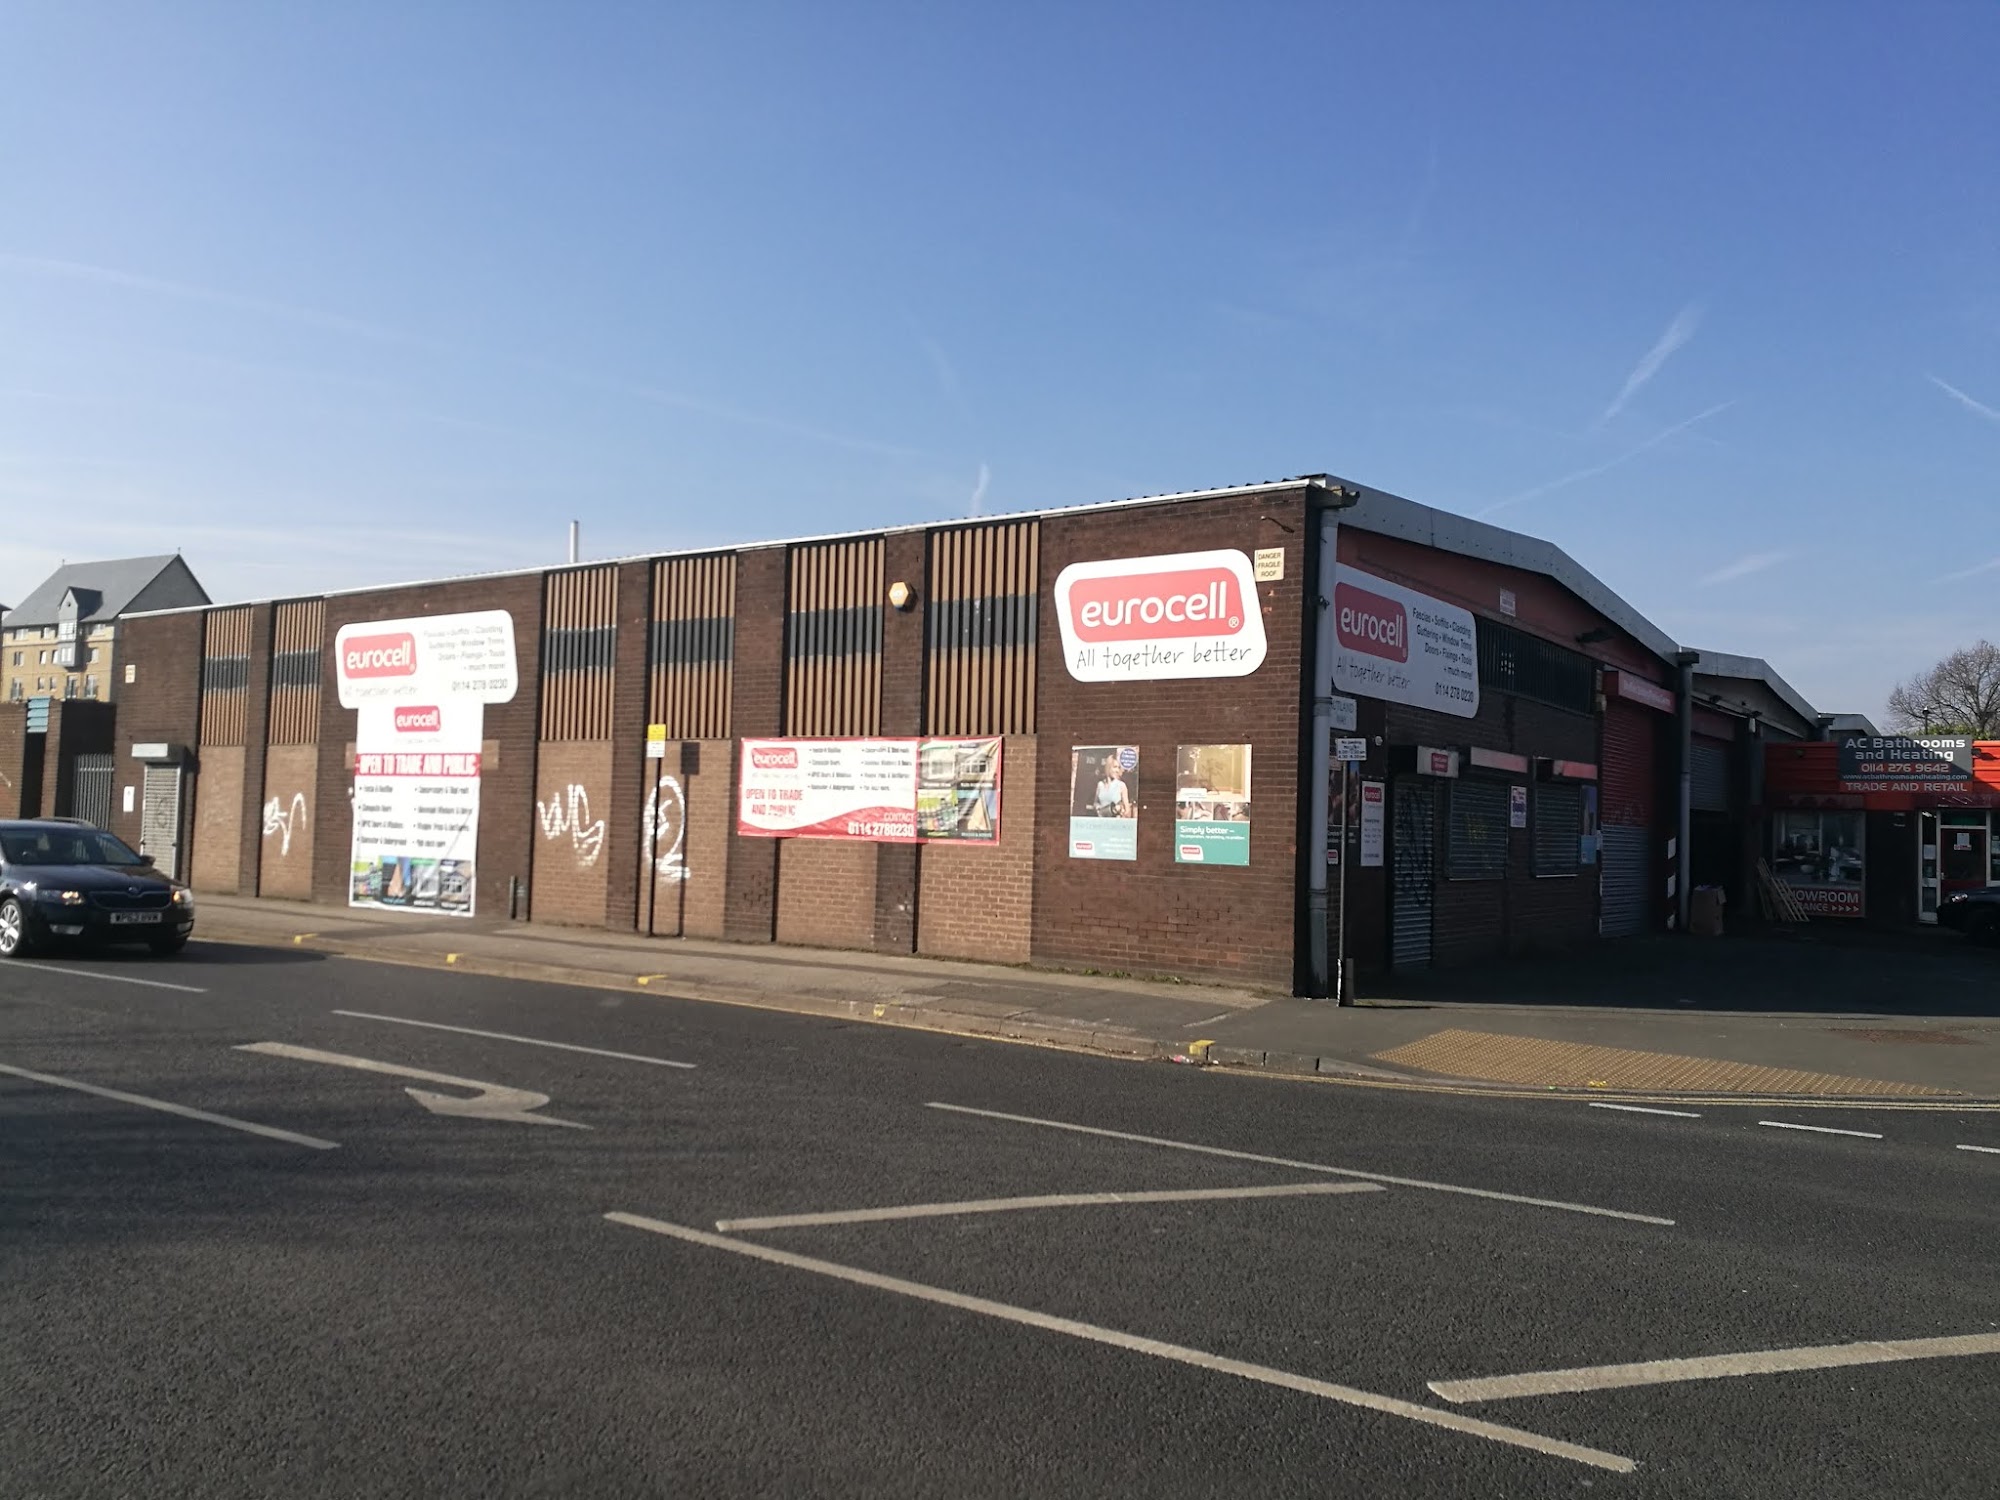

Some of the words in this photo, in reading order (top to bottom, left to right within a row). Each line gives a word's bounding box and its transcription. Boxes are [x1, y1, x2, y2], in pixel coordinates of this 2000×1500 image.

[1258, 552, 1281, 560] DANGER
[1258, 560, 1280, 568] FRAGILE
[1081, 580, 1227, 628] eurocell
[1340, 606, 1404, 648] eurocell
[346, 640, 411, 669] eurocell
[1076, 648, 1095, 669] All
[1102, 644, 1185, 671] together
[1192, 640, 1252, 664] better
[396, 710, 438, 727] eurocell
[1845, 738, 1867, 748] AC
[1872, 738, 1966, 748] Bathrooms
[754, 752, 796, 765] eurocell
[1855, 750, 1884, 760] and
[1890, 748, 1954, 762] Heating
[1861, 764, 1884, 772] 0114
[1888, 763, 1912, 772] 276
[1915, 764, 1949, 772] 9642
[1845, 782, 1888, 791] TRADE
[1892, 782, 1919, 791] AND
[1924, 782, 1968, 792] RETAIL
[768, 788, 776, 800] TO
[779, 789, 803, 800] TRADE
[1180, 826, 1205, 835] Simply
